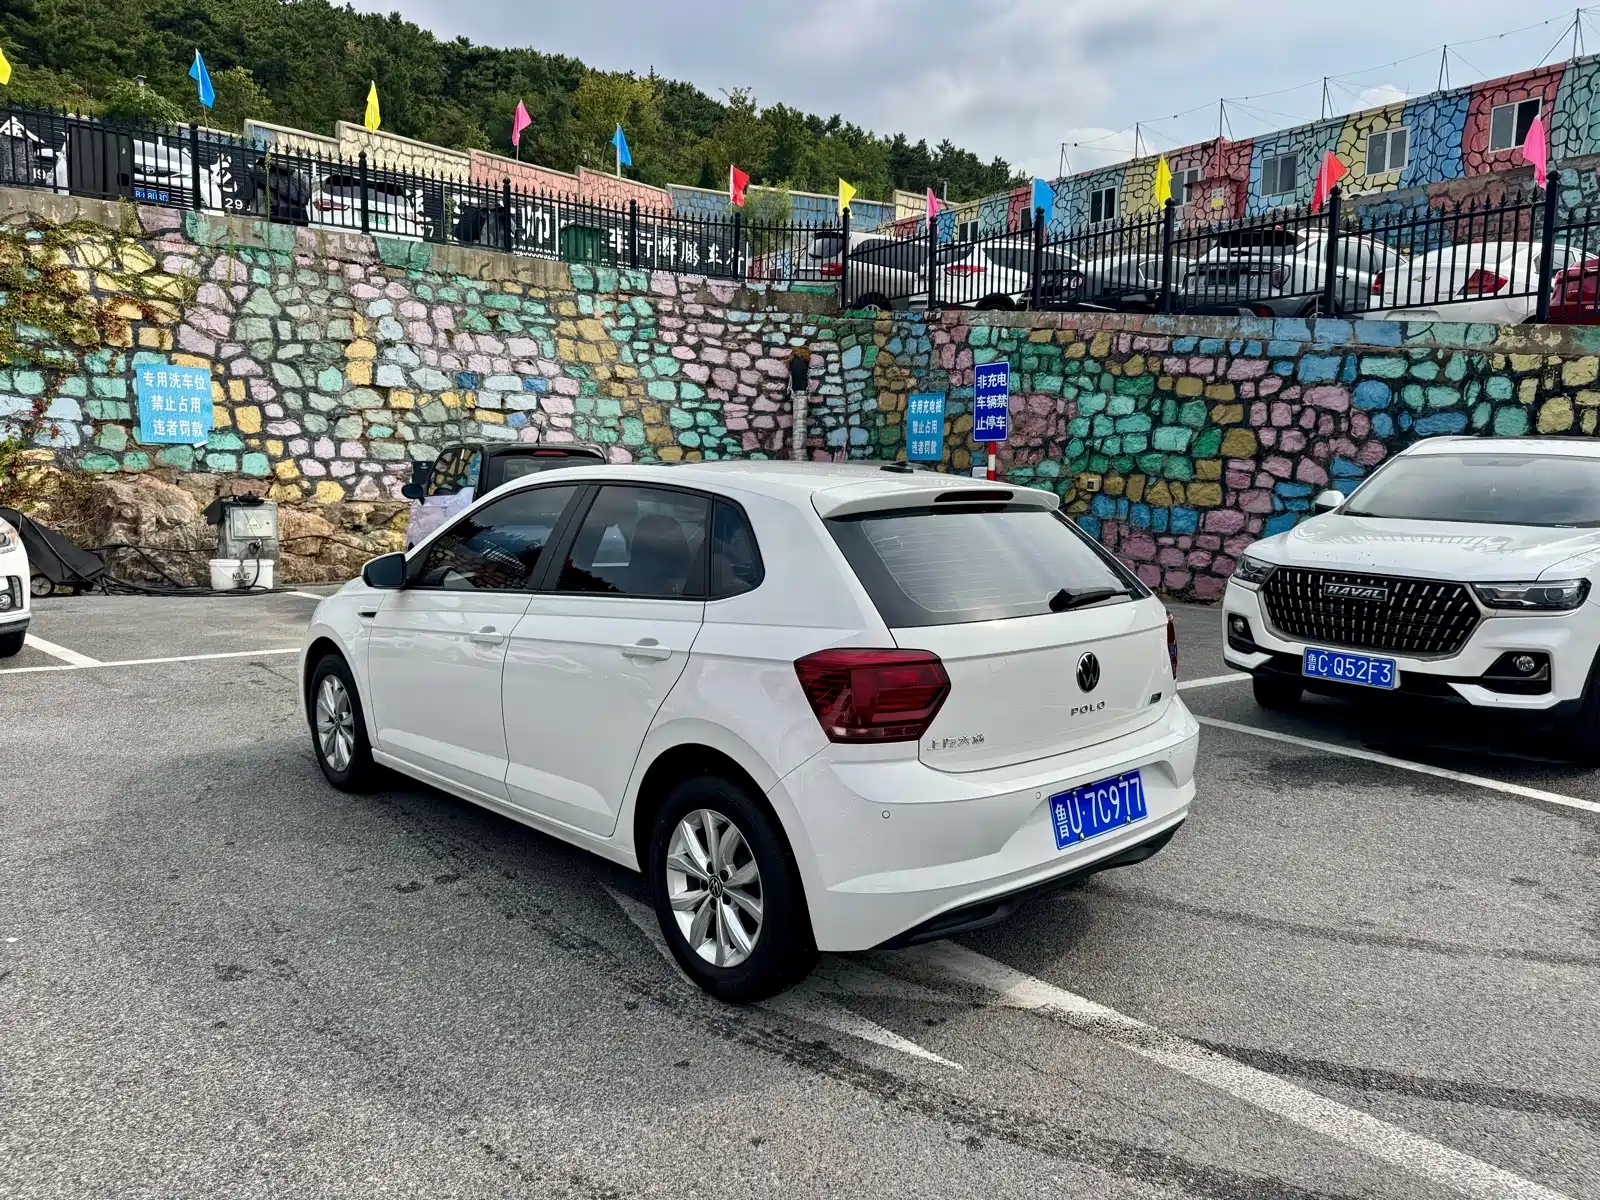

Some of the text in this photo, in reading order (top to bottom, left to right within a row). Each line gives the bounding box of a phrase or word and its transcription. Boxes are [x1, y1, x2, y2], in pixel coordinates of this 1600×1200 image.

[143, 370, 206, 391] 专用洗车位
[977, 371, 1008, 390] 非充电
[151, 394, 201, 413] 禁止占用
[911, 399, 943, 415] 专用充电桩
[976, 393, 1008, 410] 车辆禁
[153, 418, 204, 438] 违者罚款
[912, 419, 938, 435] 禁止占用
[975, 414, 1006, 431] 止停车
[911, 440, 938, 455] 违者罚款
[1327, 585, 1384, 599] HAVAL
[1071, 701, 1105, 717] POLO
